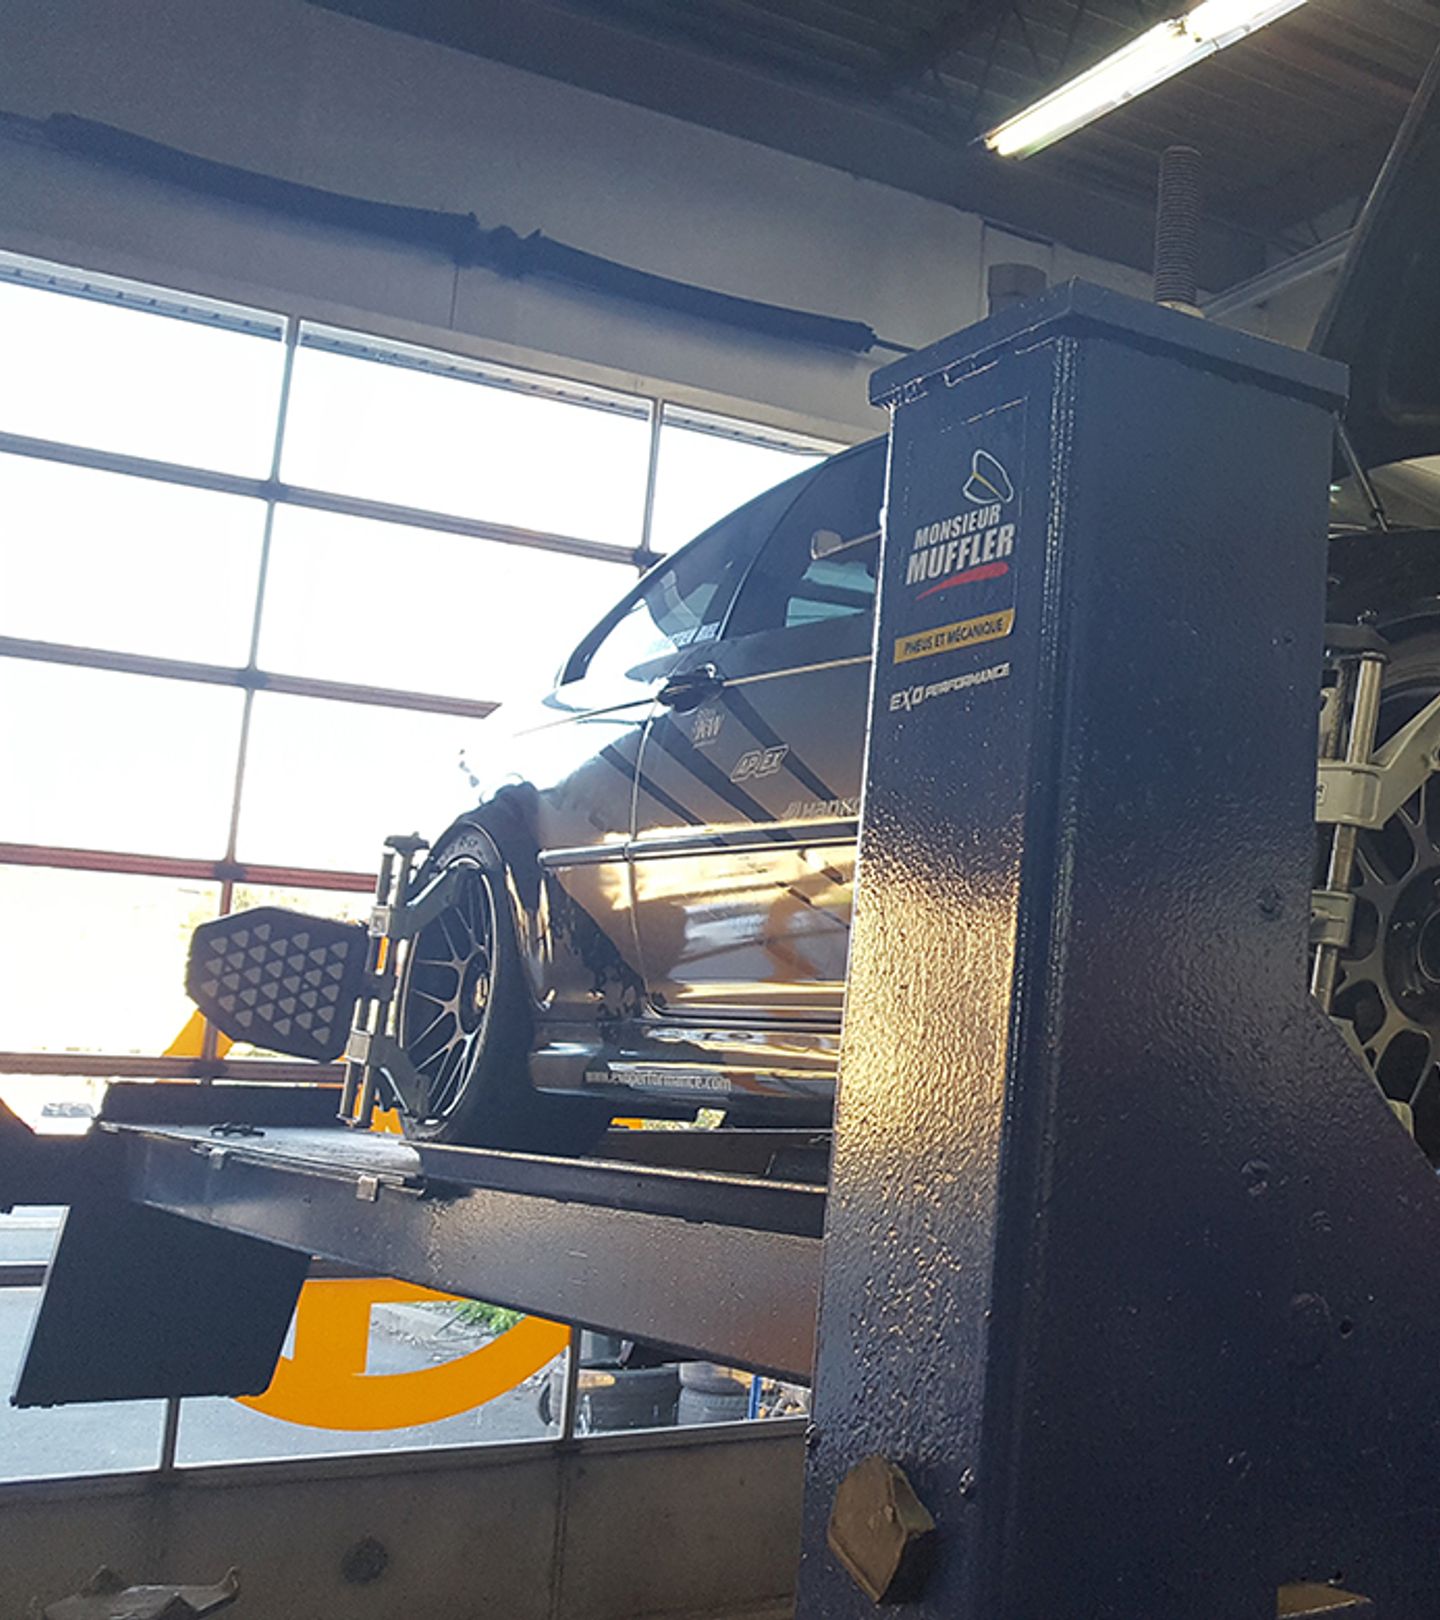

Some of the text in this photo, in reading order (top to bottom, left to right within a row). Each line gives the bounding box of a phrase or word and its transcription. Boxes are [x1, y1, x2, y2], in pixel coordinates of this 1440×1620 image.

[914, 503, 1001, 550] MONSIEUR
[906, 523, 1016, 586] MUFFLER
[934, 632, 946, 648] ET
[889, 662, 1010, 712] EXO PERFORMANCE
